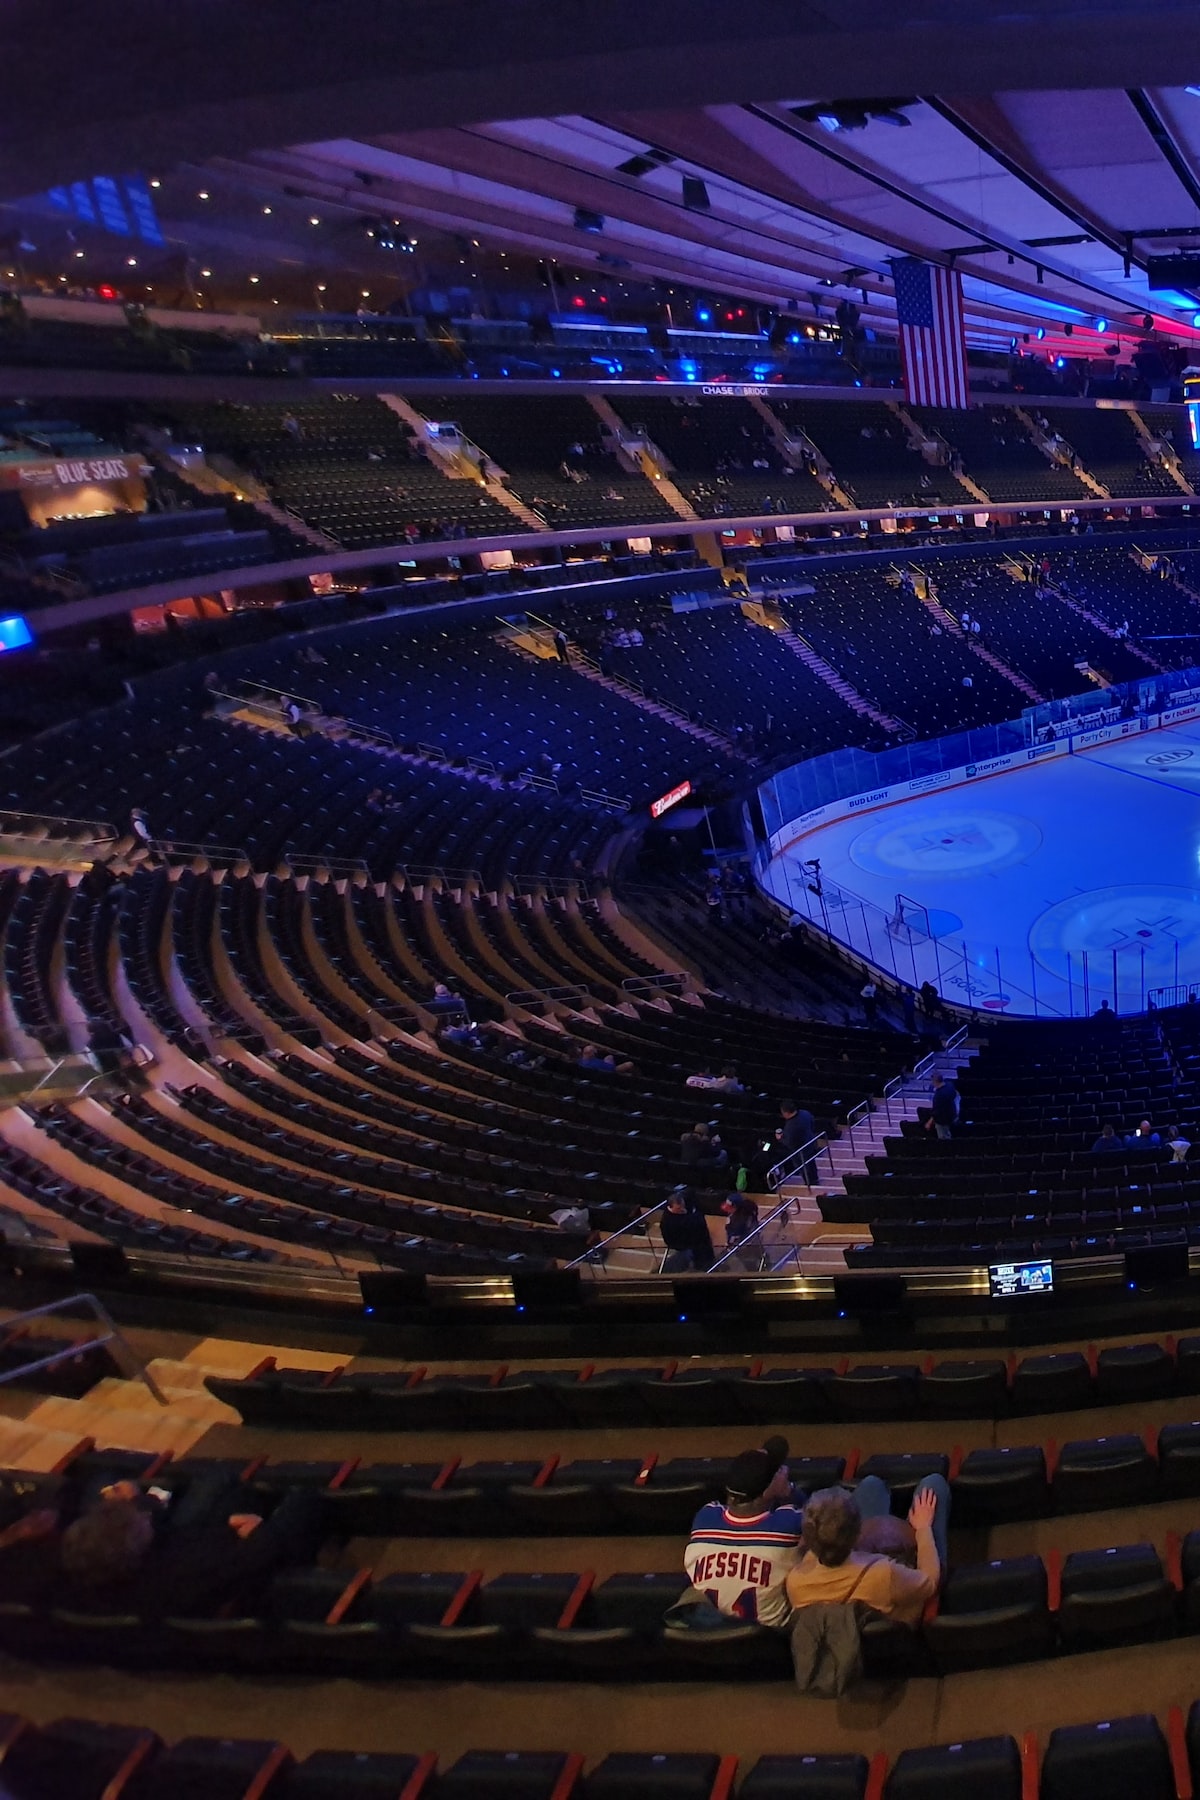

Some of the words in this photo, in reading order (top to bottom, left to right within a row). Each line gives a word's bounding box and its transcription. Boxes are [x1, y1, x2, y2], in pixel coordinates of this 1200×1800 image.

[702, 386, 734, 395] CHASE
[743, 387, 769, 396] BRIDGE
[55, 460, 92, 484] BLUE
[92, 459, 129, 482] SEATS
[1152, 752, 1188, 763] KIA
[849, 798, 866, 809] BUD
[866, 791, 889, 803] LIGHT
[694, 1551, 772, 1588] MESSIER
